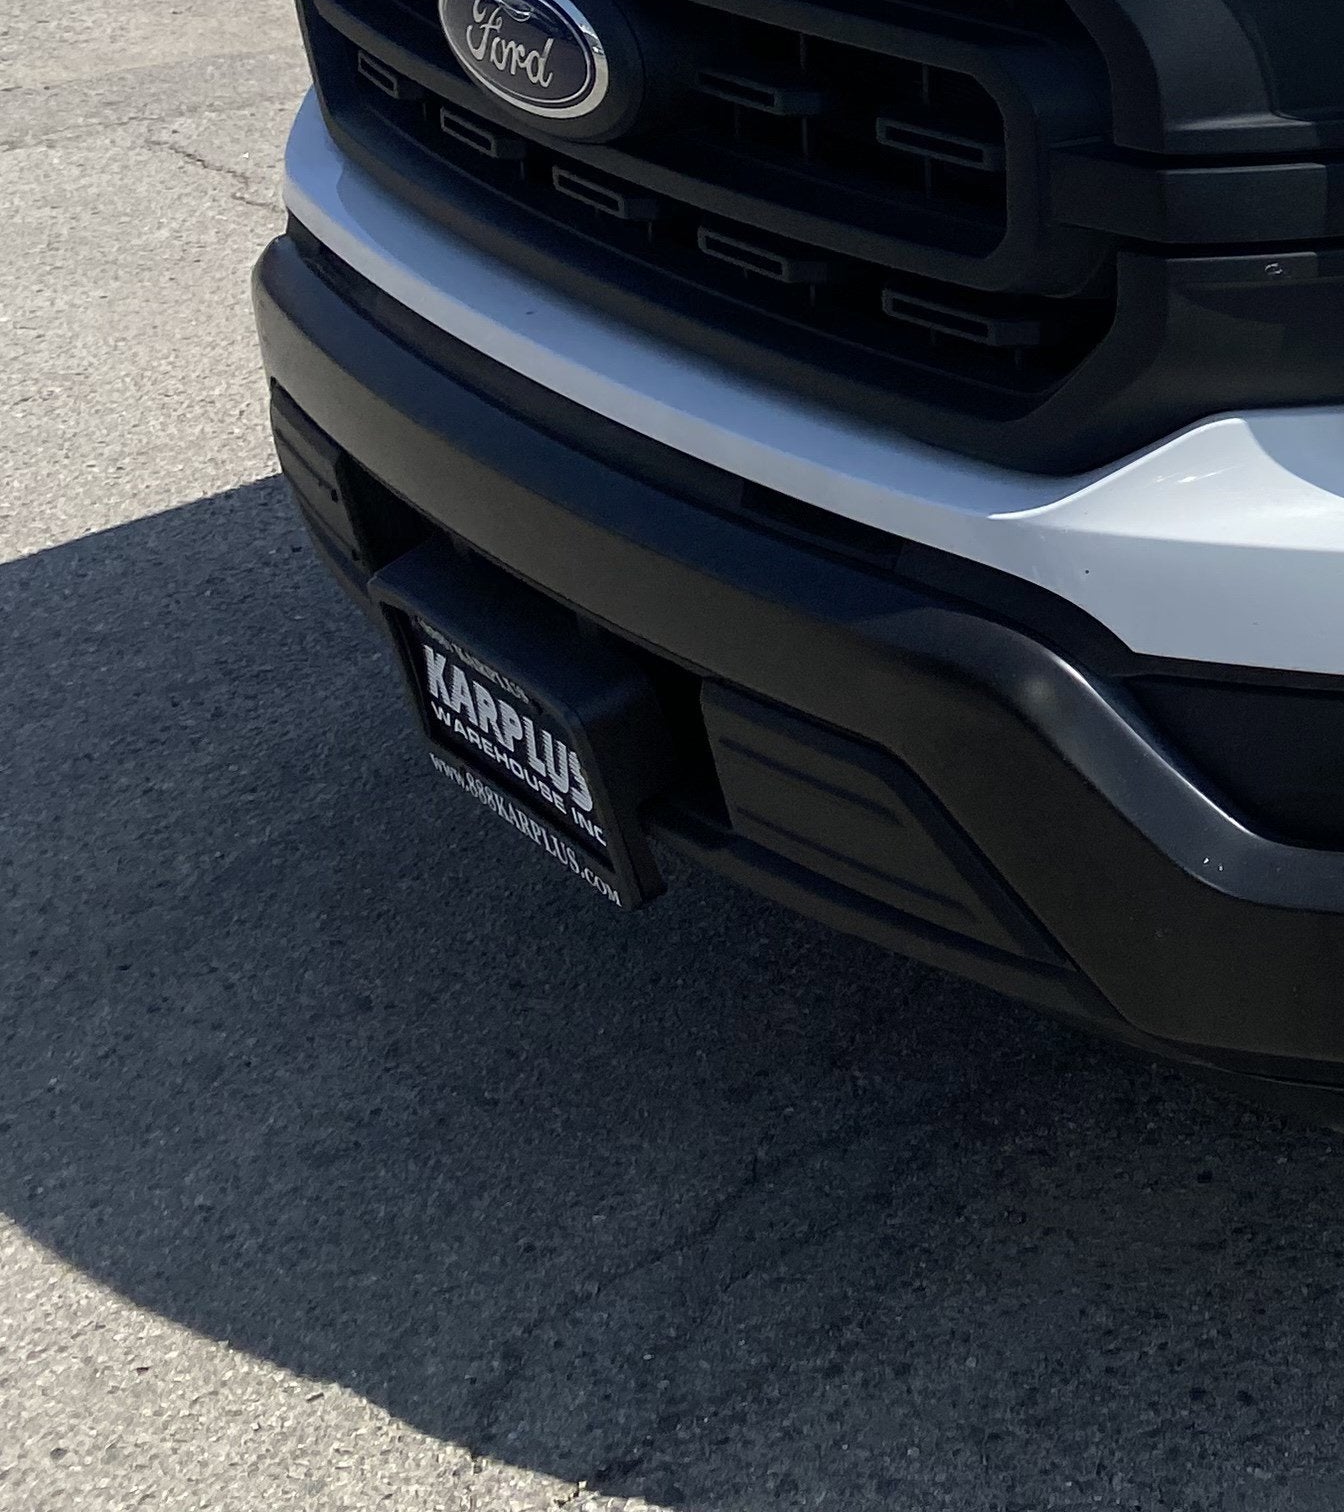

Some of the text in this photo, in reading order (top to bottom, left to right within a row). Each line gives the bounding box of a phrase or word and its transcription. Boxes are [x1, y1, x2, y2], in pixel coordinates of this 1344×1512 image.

[424, 643, 594, 812] KARPLUS
[430, 701, 608, 848] WAREHOUSE INC
